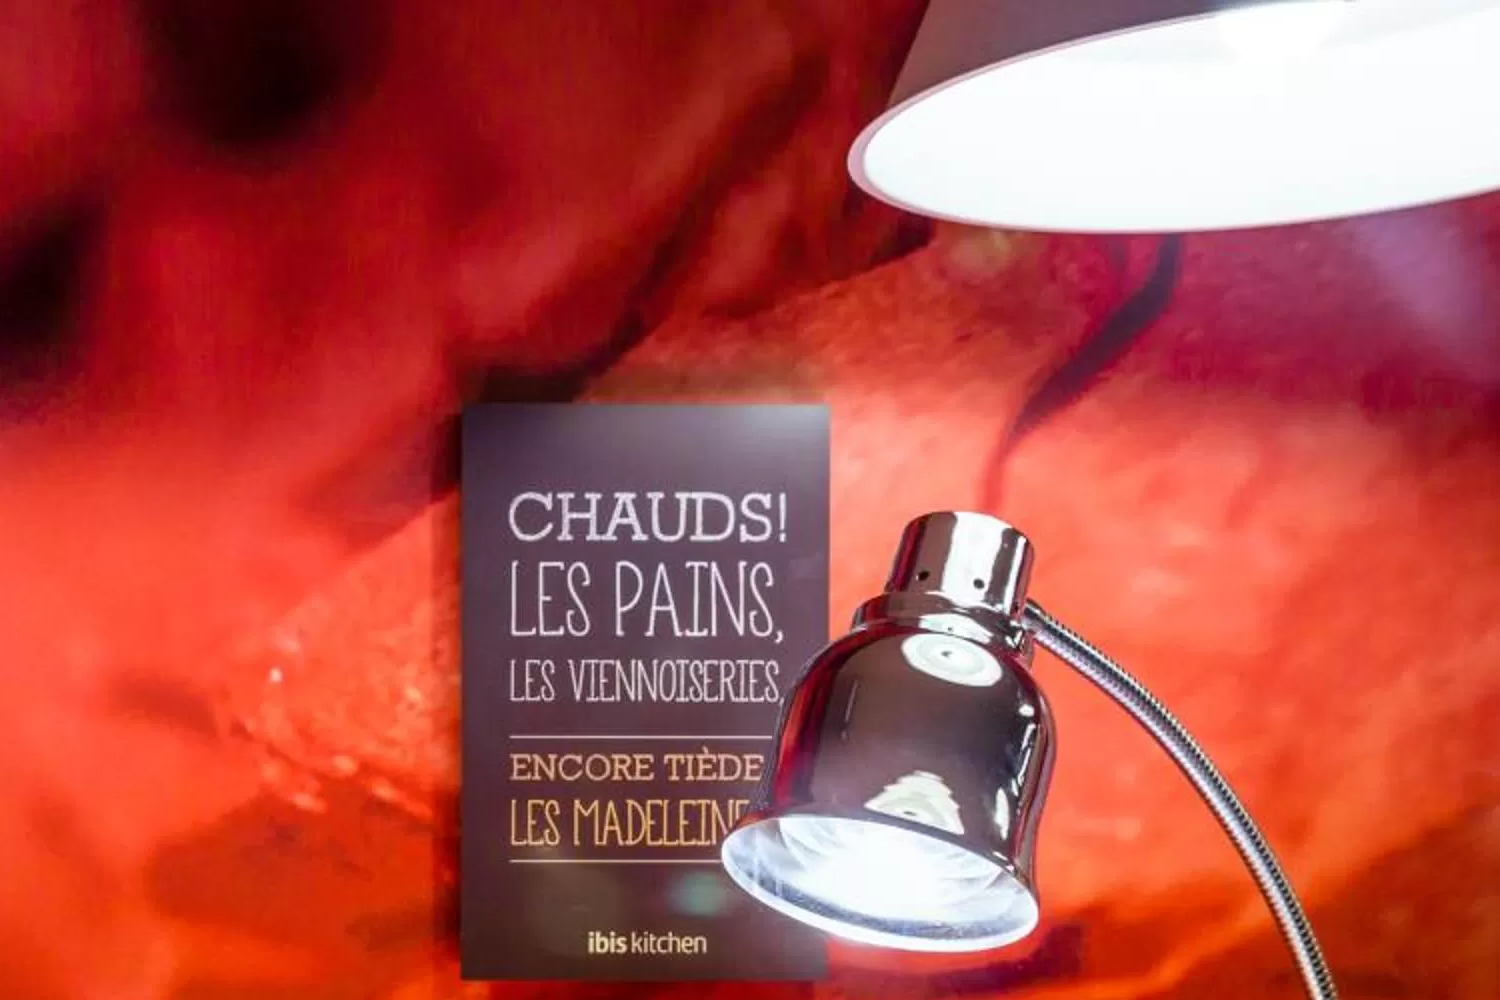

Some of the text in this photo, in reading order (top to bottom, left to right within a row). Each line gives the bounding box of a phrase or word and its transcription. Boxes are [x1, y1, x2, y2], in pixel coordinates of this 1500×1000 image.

[508, 491, 787, 544] CHAUDS!
[509, 560, 785, 645] LES PAINS,
[509, 659, 785, 705] LES VIENNOISERIES,
[509, 753, 655, 782] ENCORE
[509, 800, 560, 846] LES
[588, 931, 708, 954] ibis kitchen
